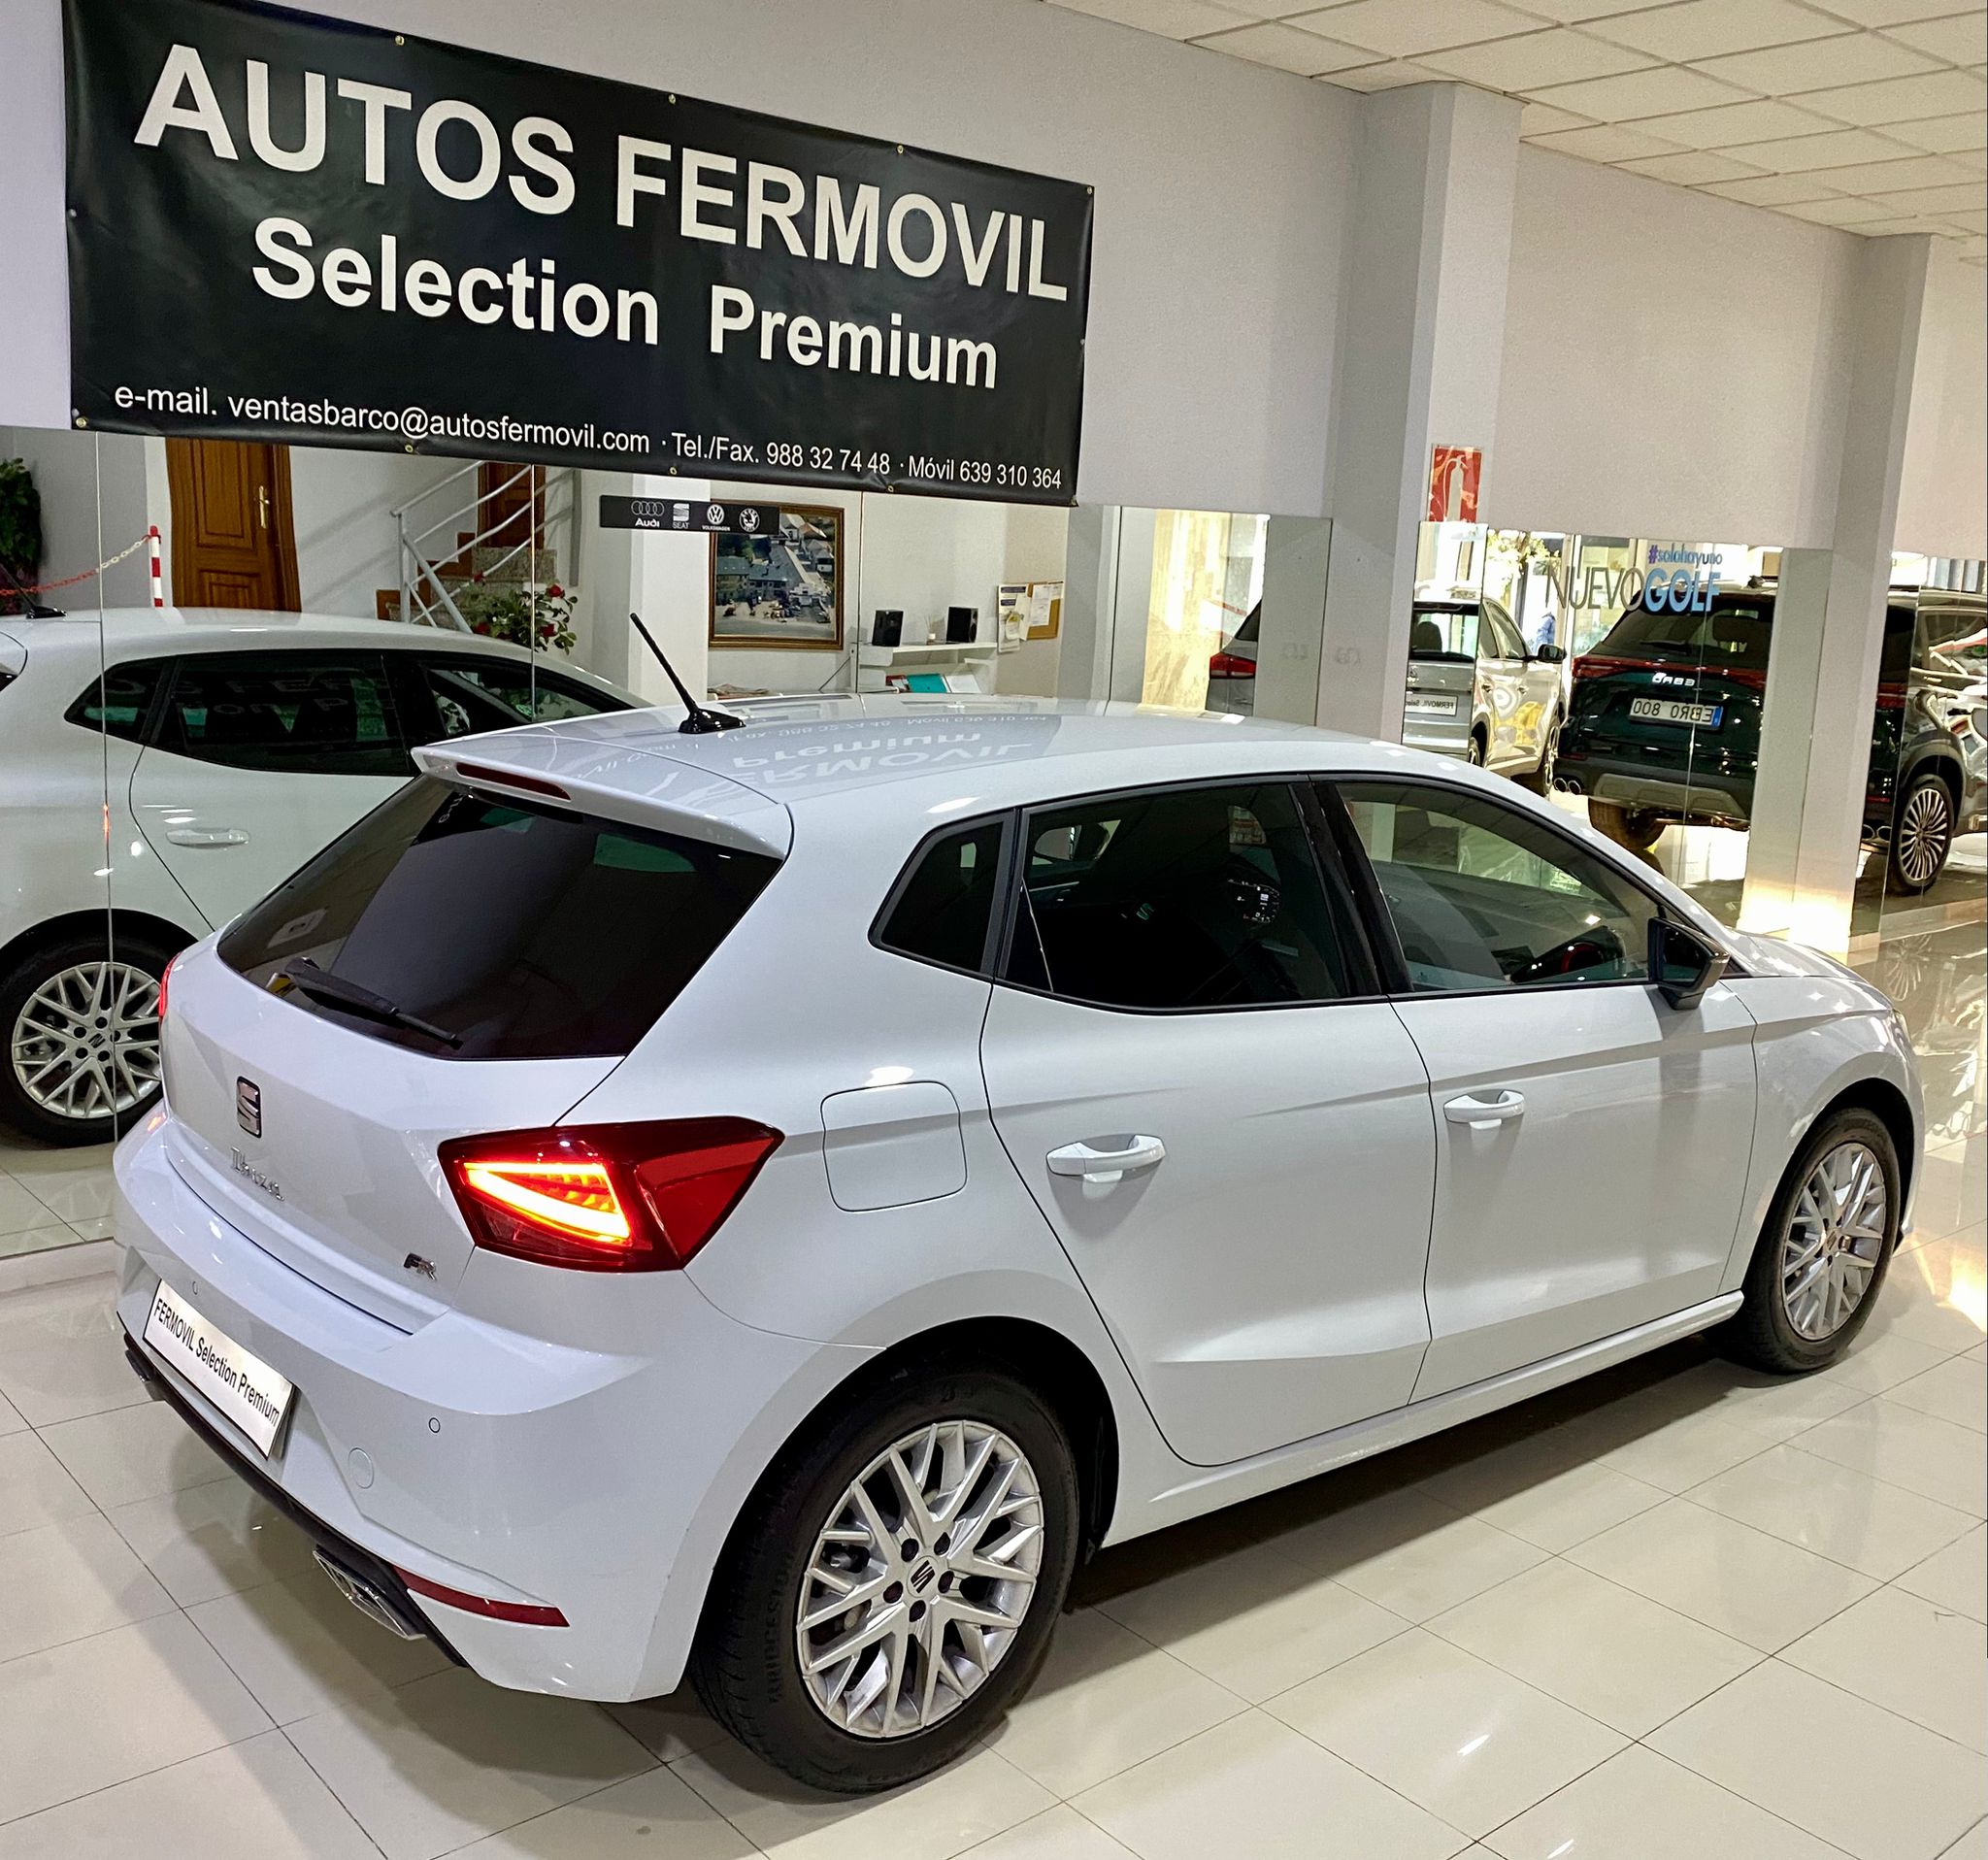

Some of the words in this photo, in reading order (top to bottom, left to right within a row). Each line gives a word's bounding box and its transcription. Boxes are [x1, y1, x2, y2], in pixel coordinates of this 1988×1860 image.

[133, 44, 577, 216] AUTOS
[615, 134, 1069, 302] FERMOVIL
[251, 216, 659, 346] Selection
[710, 284, 997, 389] Premium
[115, 385, 217, 415] e-mail.
[227, 396, 650, 454] ventasbarco@autosfermovil.com
[766, 442, 804, 468] 988
[810, 446, 834, 470] 32
[839, 448, 863, 473] 74
[867, 451, 891, 475] 48
[909, 454, 955, 482] Móvil
[959, 460, 992, 483] 639
[996, 463, 1028, 486] 310
[1032, 467, 1062, 489] 364
[635, 517, 660, 528] Audi
[672, 521, 690, 530] SEAT
[153, 1297, 196, 1352] FERMOVIL
[195, 1336, 238, 1389] Selection
[237, 1372, 281, 1428] Premium
